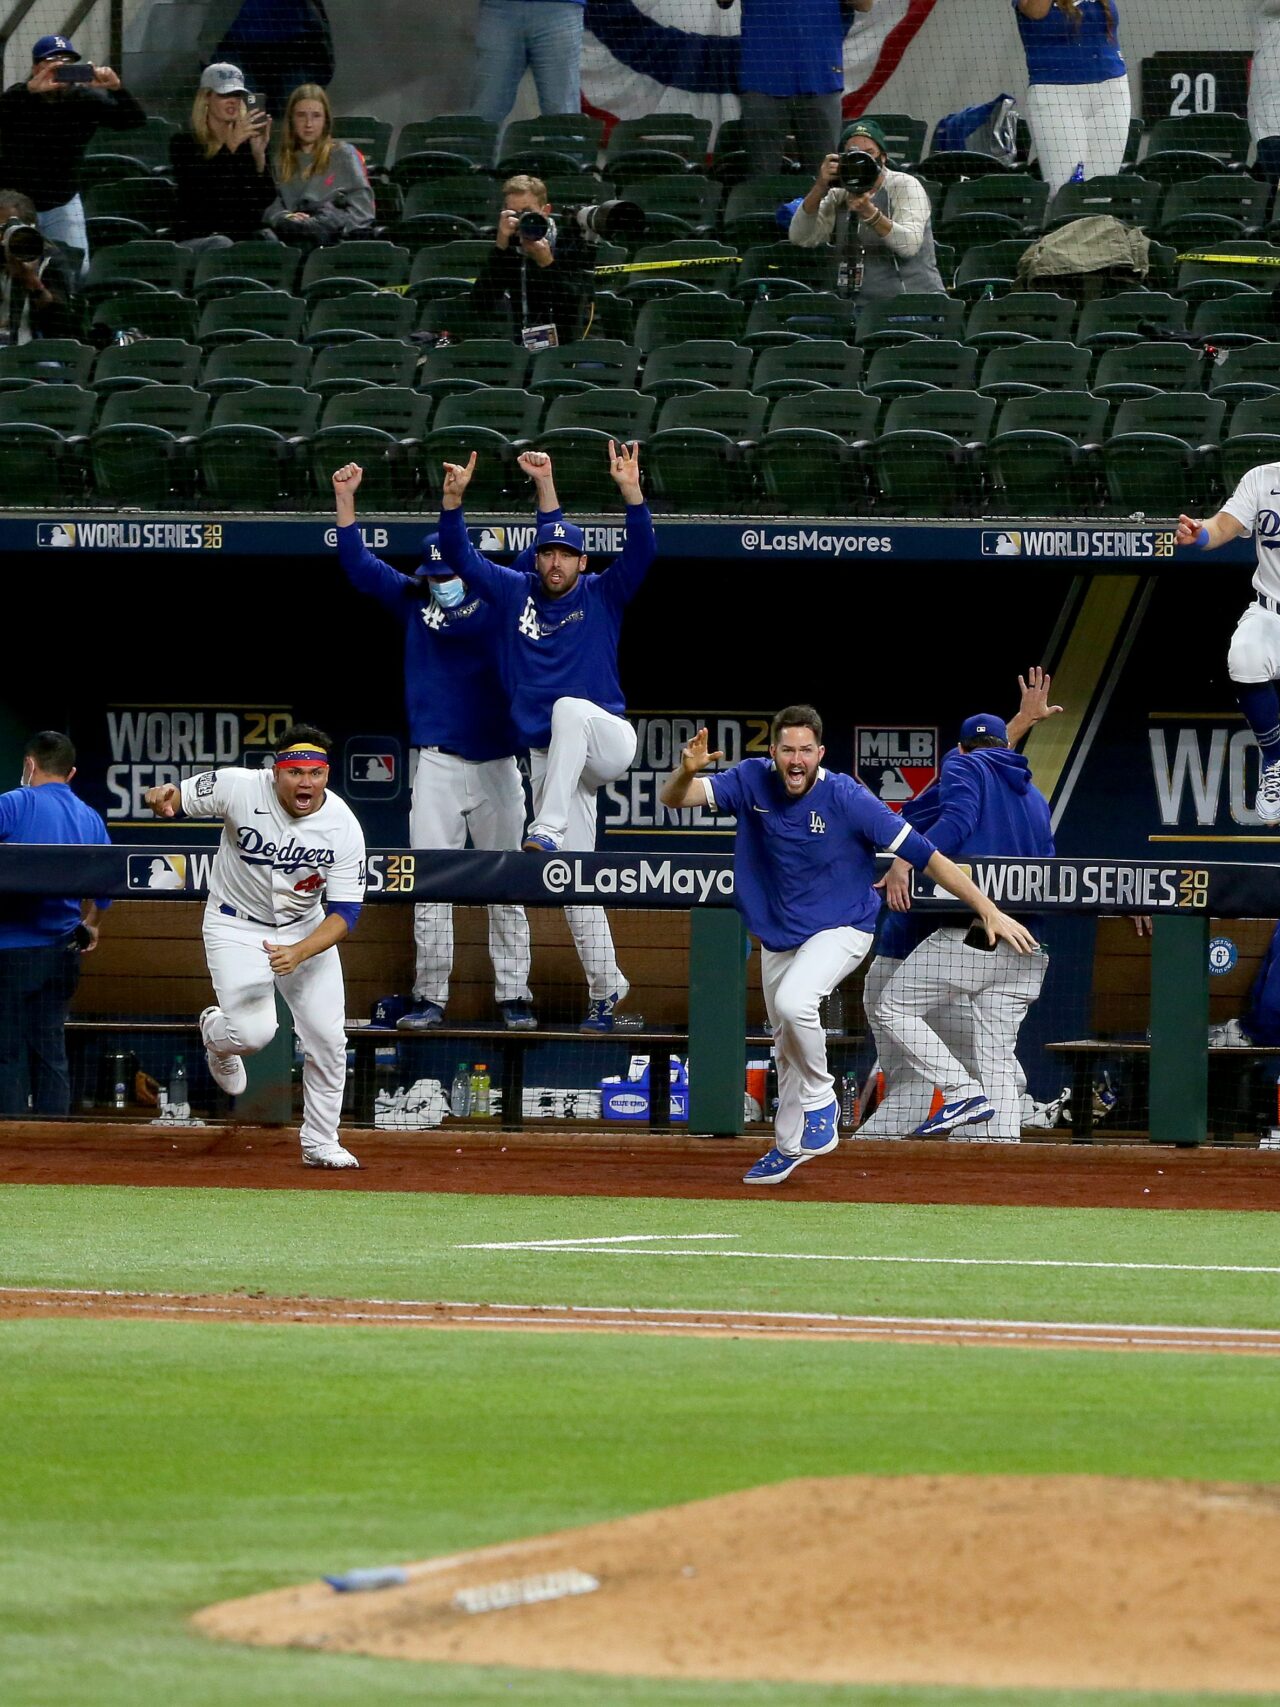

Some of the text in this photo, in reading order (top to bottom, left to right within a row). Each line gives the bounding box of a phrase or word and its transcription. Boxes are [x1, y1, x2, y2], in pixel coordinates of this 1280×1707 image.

[1169, 73, 1216, 117] 20
[77, 524, 202, 549] WORLD SERIES
[204, 525, 222, 537] 20
[324, 528, 389, 548] @LB
[553, 521, 566, 538] LA
[1154, 532, 1174, 544] 20
[204, 537, 222, 549] 20
[430, 544, 442, 561] LA
[741, 530, 892, 556] @LasMayores
[1023, 531, 1153, 557] WORLD SERIES
[1154, 545, 1174, 557] 20
[106, 711, 293, 763] WORLD 20
[859, 732, 935, 758] MLB
[859, 757, 934, 768] NETWORK
[809, 810, 826, 834] LA
[236, 826, 336, 874] Dodgers
[386, 855, 415, 874] 20
[386, 874, 415, 892] 20
[542, 859, 734, 902] @LasMayo
[976, 863, 1178, 908] WORLD SERIES
[1179, 870, 1209, 889] 20
[1178, 888, 1209, 909] 20
